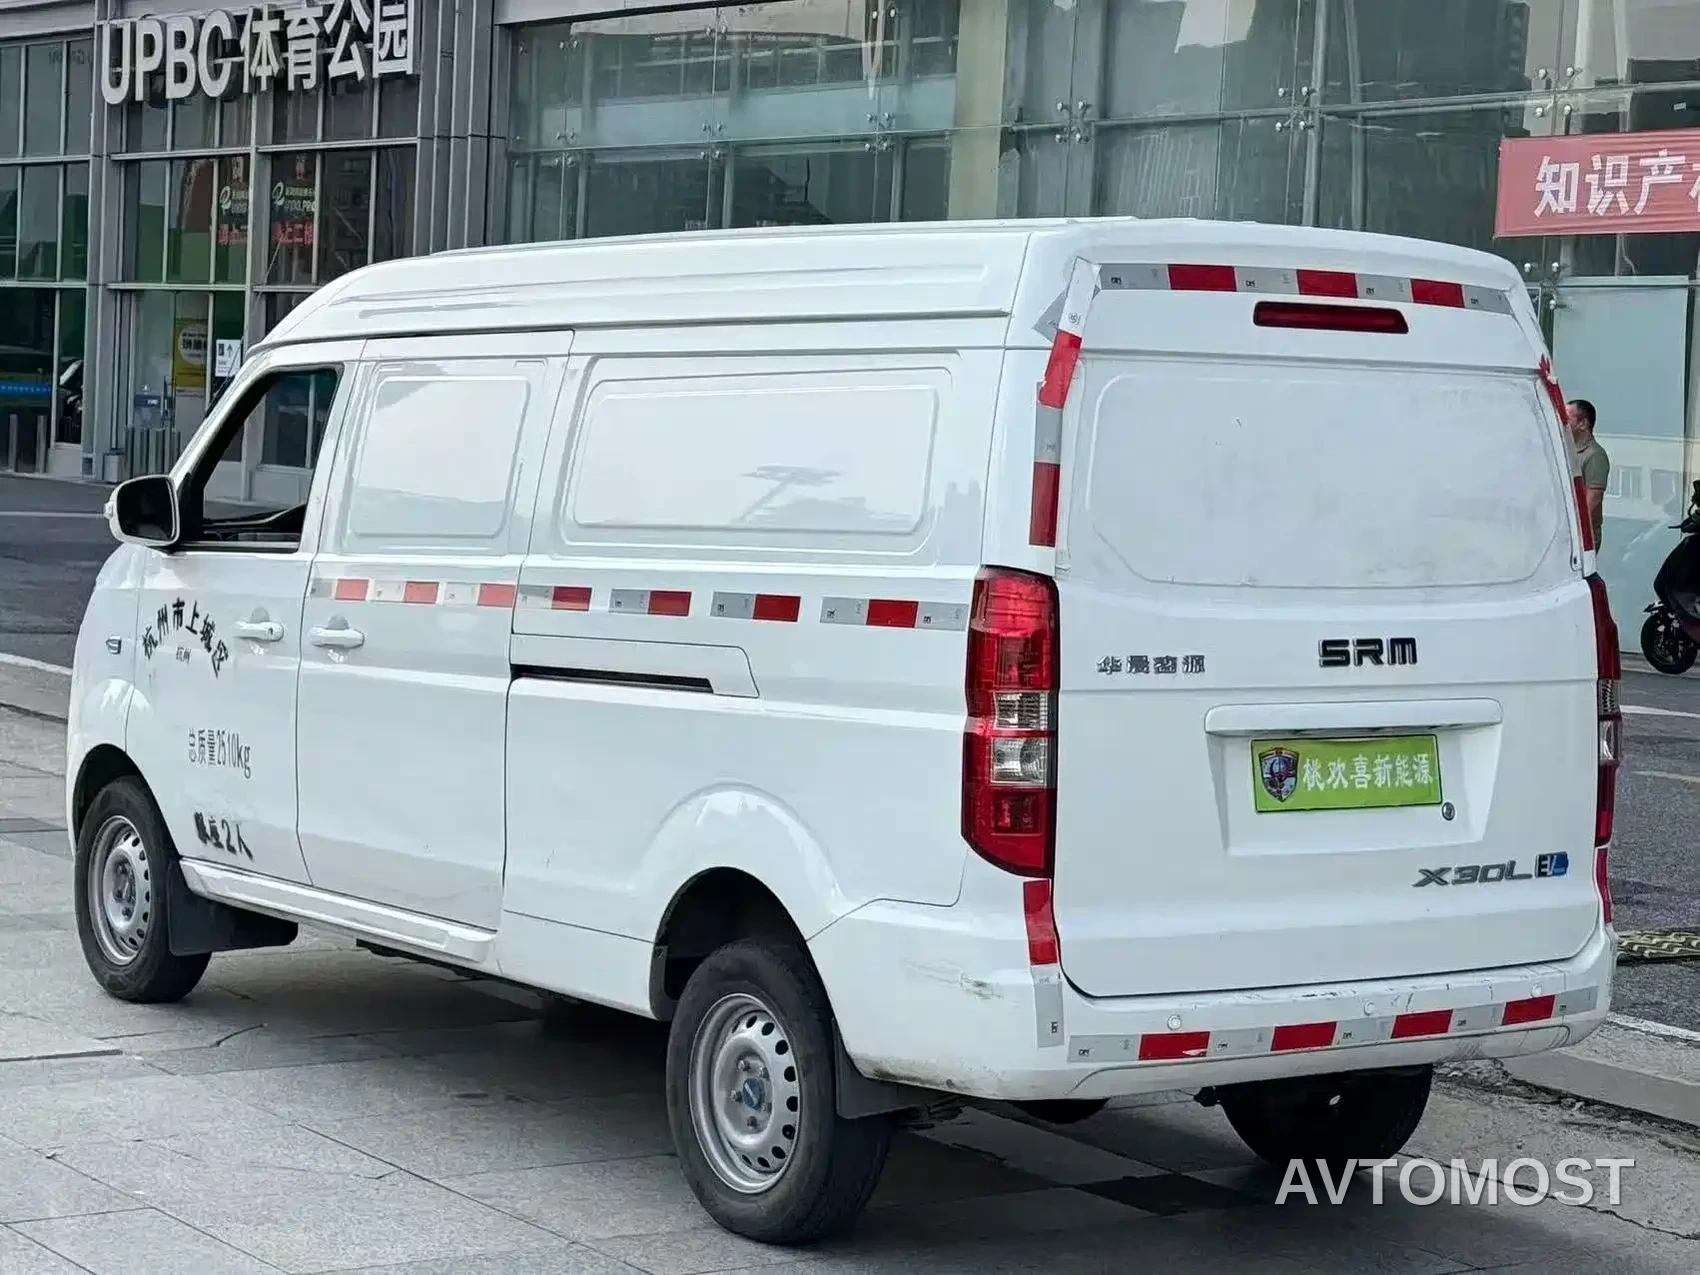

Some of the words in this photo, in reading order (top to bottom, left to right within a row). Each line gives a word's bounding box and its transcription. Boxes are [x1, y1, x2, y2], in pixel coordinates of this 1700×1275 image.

[1534, 149, 1700, 218] 知识产
[1318, 637, 1418, 667] SRM
[188, 728, 251, 779] 总质量2510kg
[1302, 753, 1433, 791] 桃欢喜新能源
[1412, 860, 1533, 887] X30L
